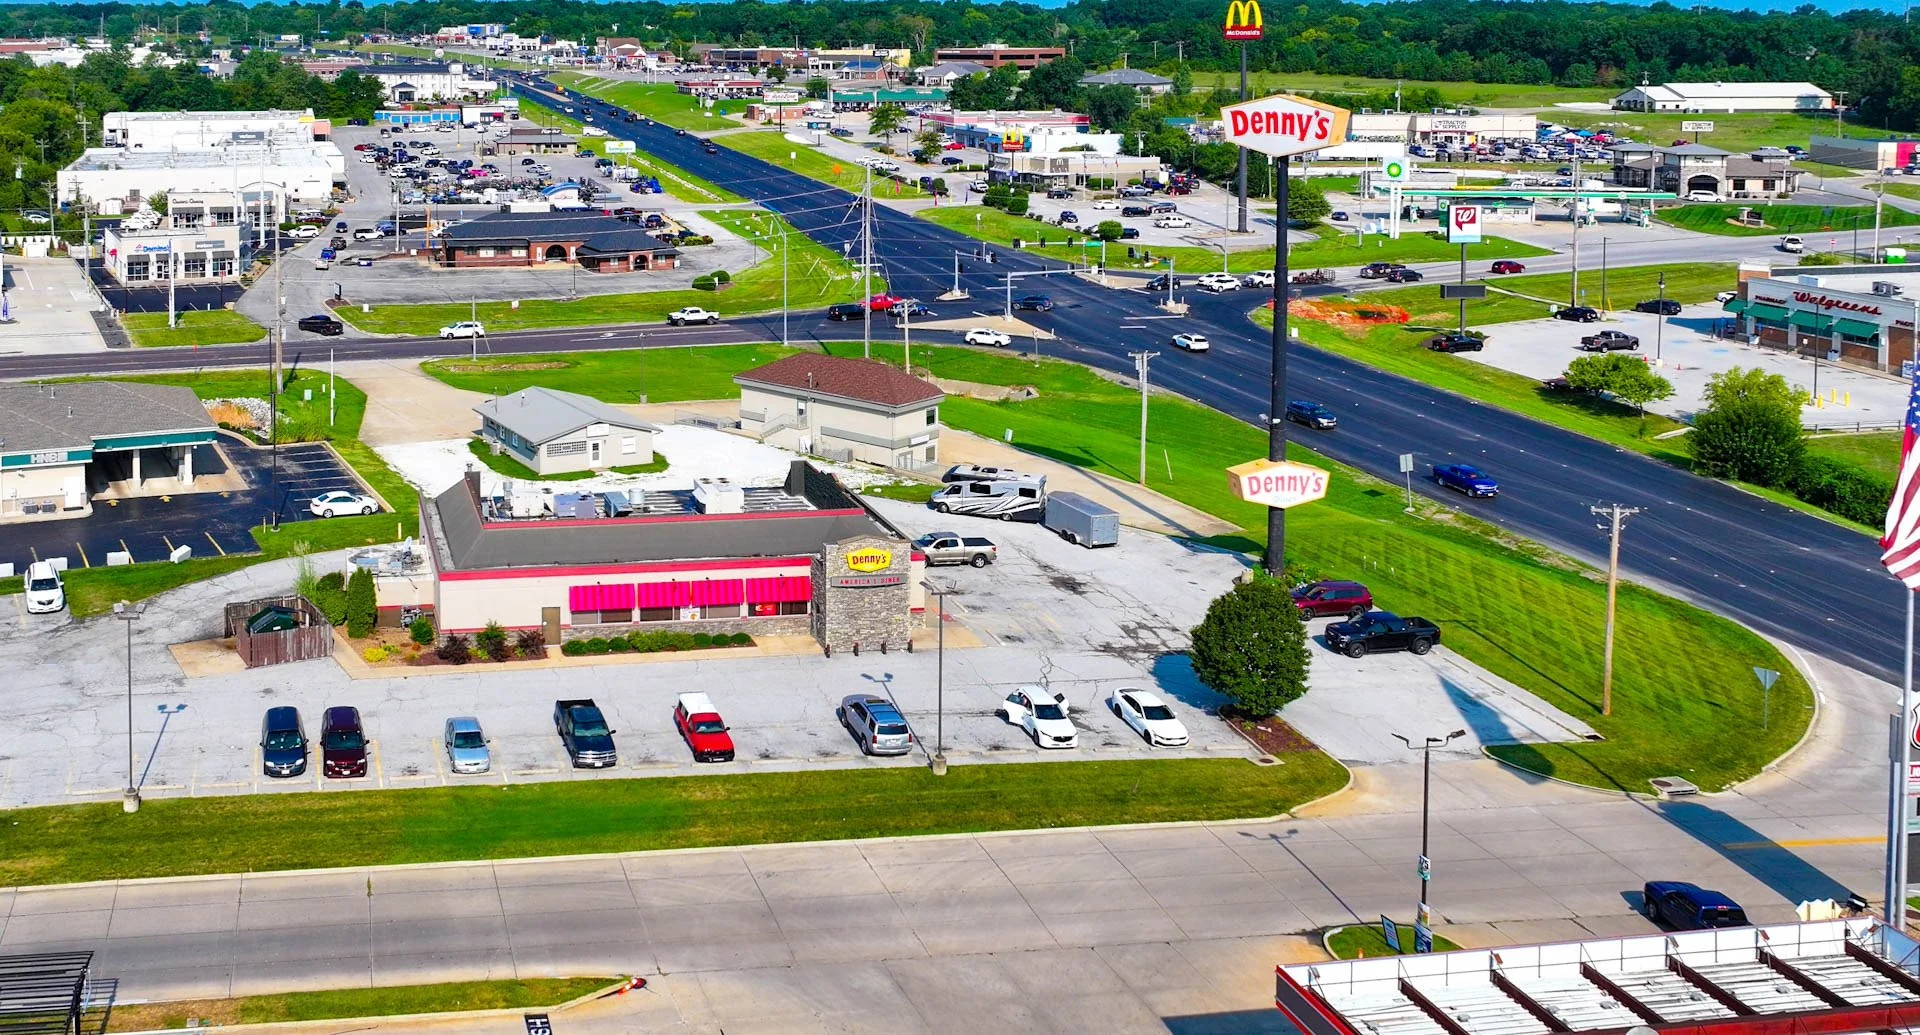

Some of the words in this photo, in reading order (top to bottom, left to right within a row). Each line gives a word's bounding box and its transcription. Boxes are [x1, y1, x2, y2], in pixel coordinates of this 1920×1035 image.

[1230, 110, 1330, 141] Denny's
[1755, 295, 1786, 304] PHARMACY
[1792, 292, 1882, 315] Walgreens
[1895, 319, 1914, 328] PHOT
[31, 452, 58, 464] HNB
[1247, 472, 1324, 496] Denny's
[852, 554, 887, 565] Denny's
